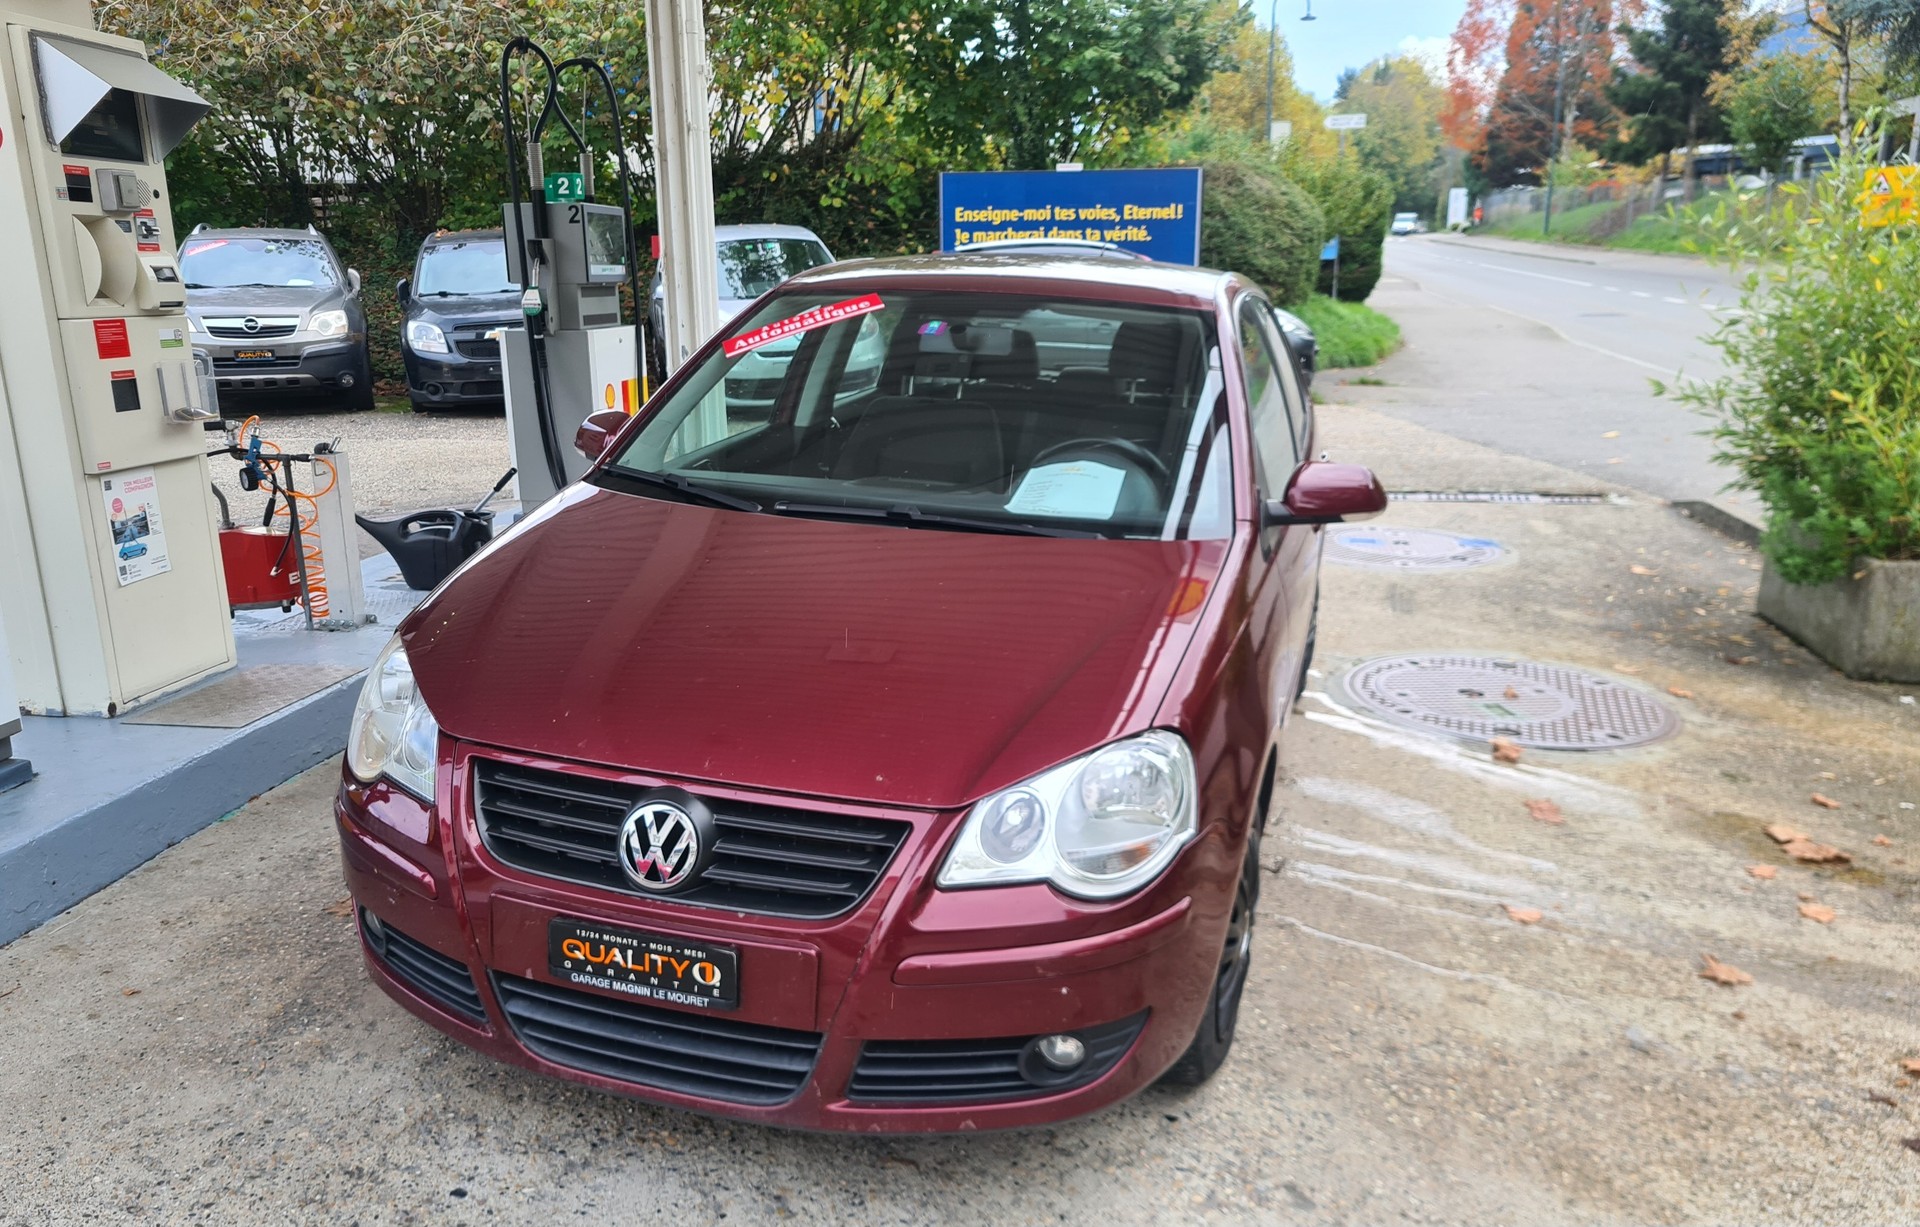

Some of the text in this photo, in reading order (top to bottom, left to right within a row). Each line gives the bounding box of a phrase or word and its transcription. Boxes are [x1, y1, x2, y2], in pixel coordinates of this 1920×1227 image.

[557, 177, 583, 195] 2 2
[568, 204, 581, 224] 2
[954, 205, 1052, 226] Enseigne-moi
[1054, 206, 1077, 221] tes
[1078, 204, 1121, 223] voies,
[954, 225, 1153, 246] Je marcherai dans ta vérité.
[734, 300, 872, 350] Automatique
[576, 929, 600, 940] 12/24
[602, 934, 638, 947] MONATE
[649, 942, 672, 953] MOIS
[571, 972, 710, 1008] GARAGE MAGNIN LE MOURET
